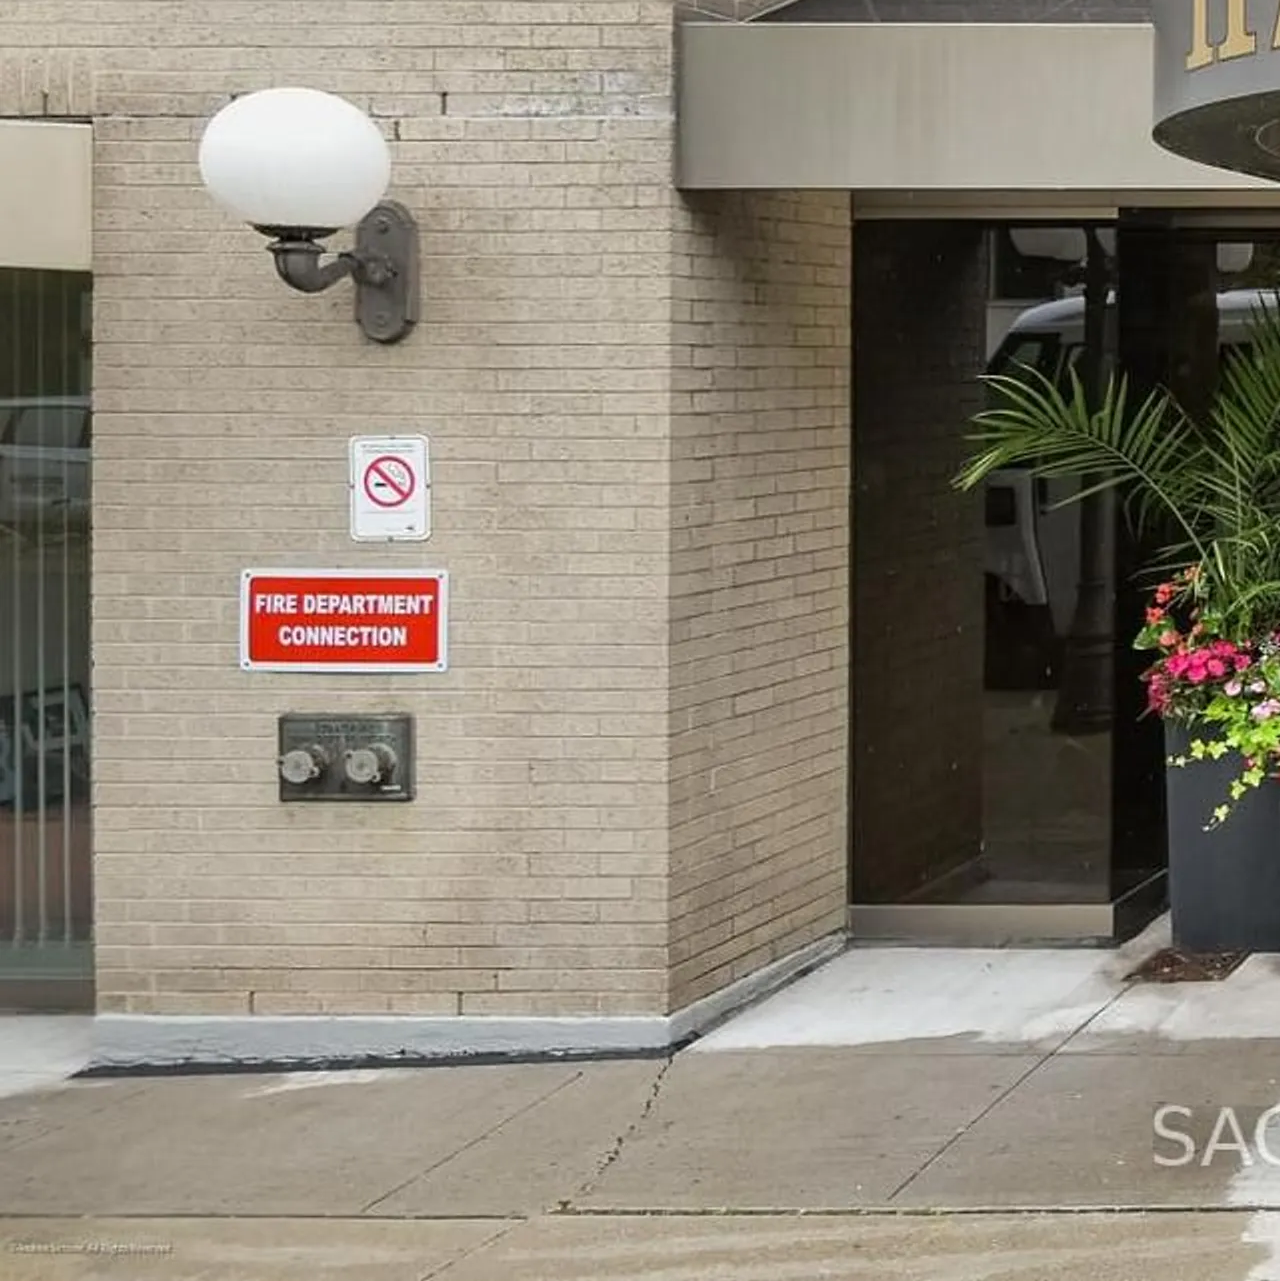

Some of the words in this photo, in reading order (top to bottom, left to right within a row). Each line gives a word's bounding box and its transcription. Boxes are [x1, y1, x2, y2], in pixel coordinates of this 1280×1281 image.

[255, 595, 296, 615] FIRE
[302, 594, 433, 615] DEPARTMENT
[278, 626, 407, 646] CONNECTION
